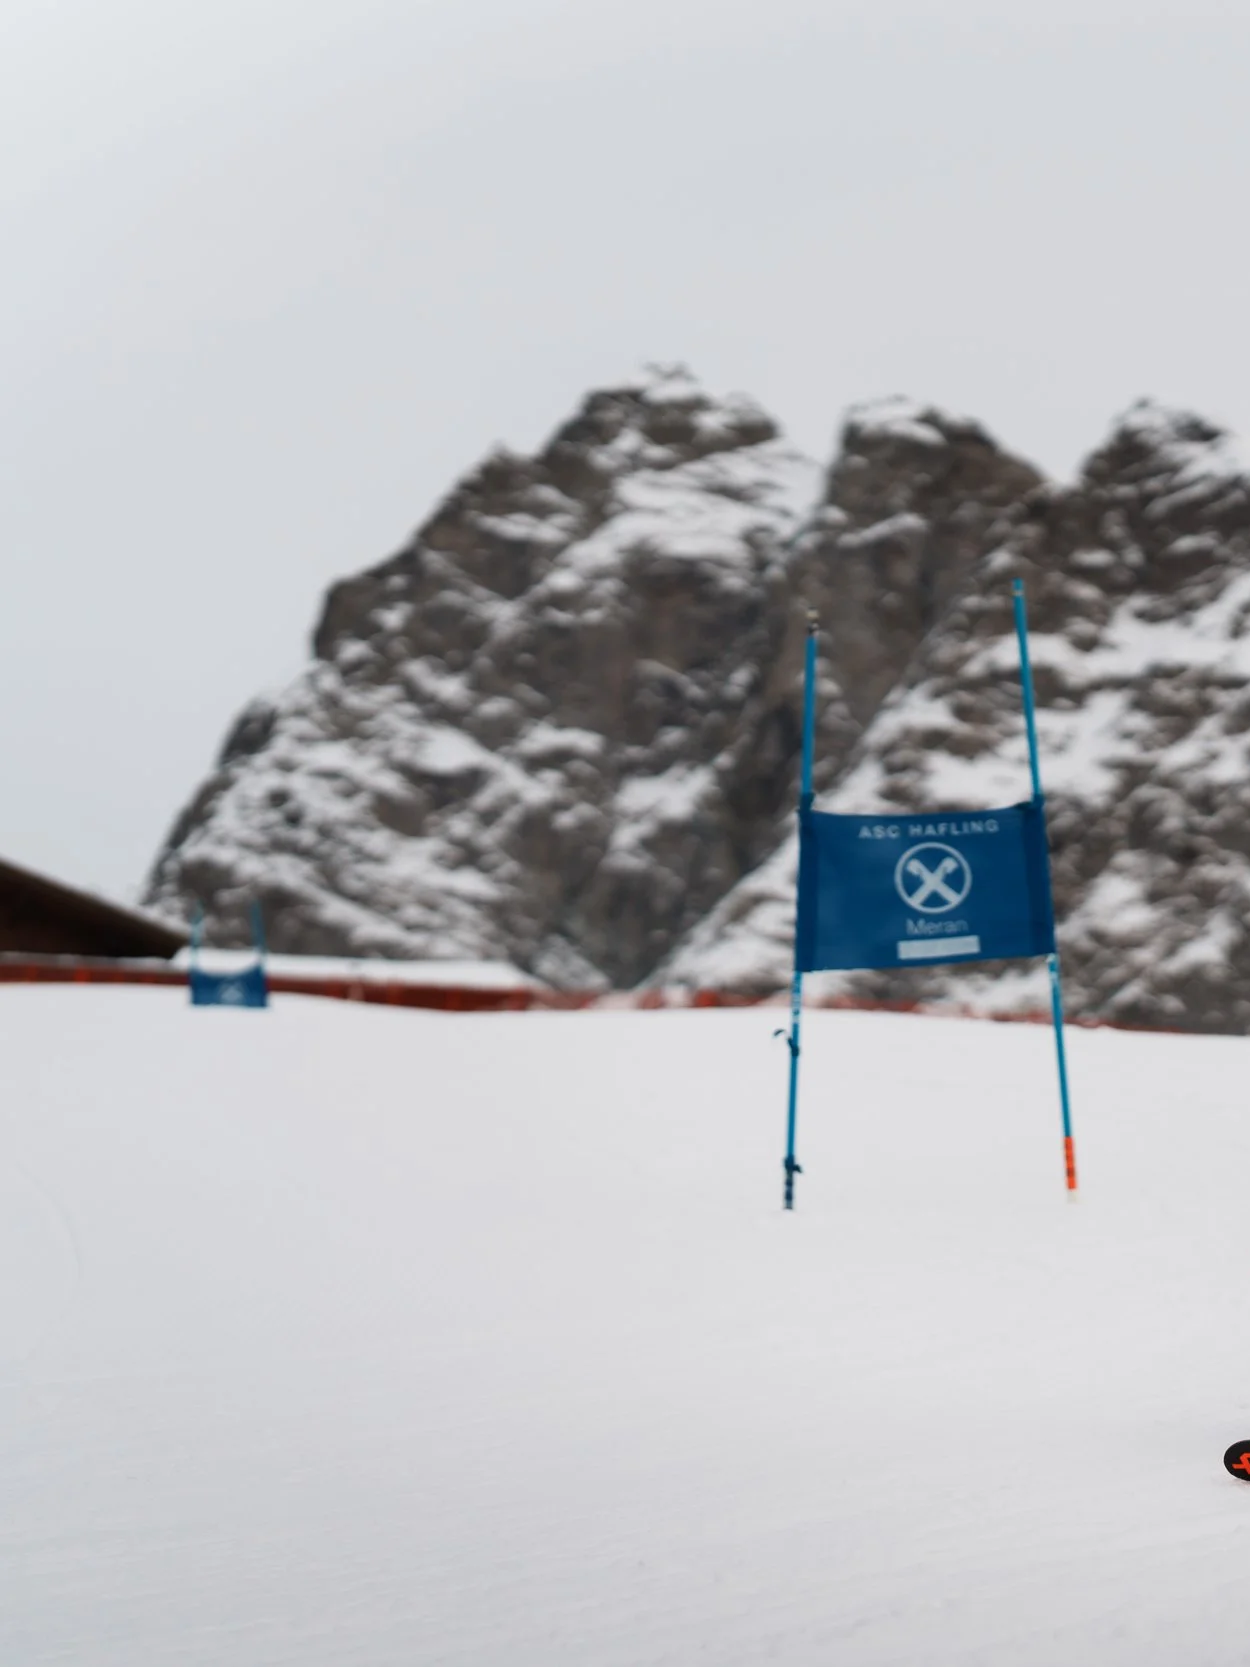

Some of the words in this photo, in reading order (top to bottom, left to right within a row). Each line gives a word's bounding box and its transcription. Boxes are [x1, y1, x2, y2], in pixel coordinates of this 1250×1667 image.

[858, 825, 900, 839] ASC
[908, 819, 999, 837] HAFLING
[906, 917, 969, 935] Meran
